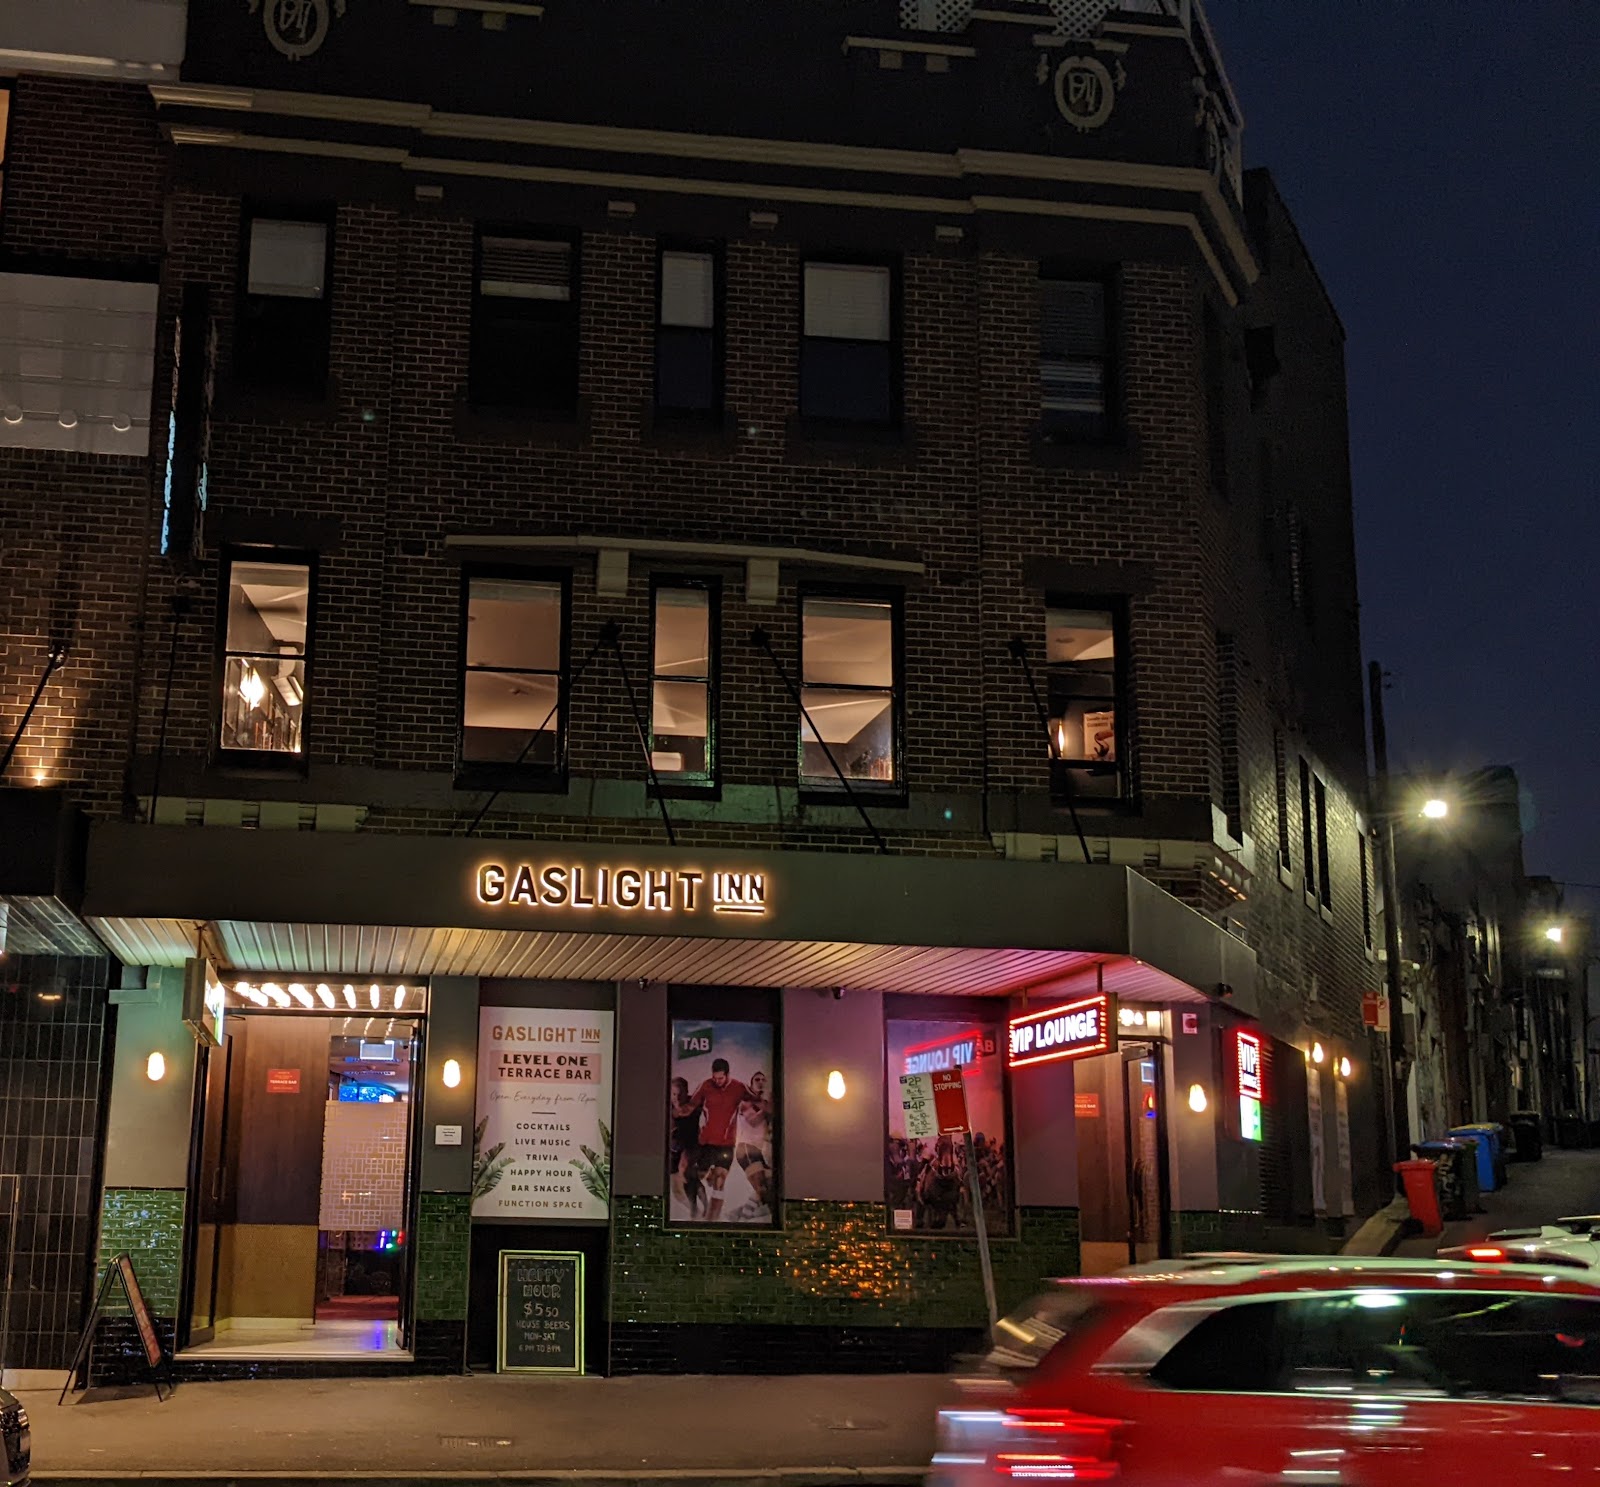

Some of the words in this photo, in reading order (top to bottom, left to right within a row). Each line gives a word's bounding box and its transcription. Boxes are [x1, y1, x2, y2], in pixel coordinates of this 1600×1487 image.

[476, 864, 703, 911] GASLIGHT
[713, 871, 766, 904] INN
[492, 1025, 577, 1042] GASLIGHT
[581, 1028, 601, 1040] INN
[1012, 1026, 1034, 1053] VIP
[1035, 1009, 1098, 1048] LOUNGE
[682, 1037, 710, 1050] TAB
[503, 1053, 552, 1065] LEVEL
[556, 1055, 589, 1067] ONE
[498, 1067, 561, 1079] TERRACE
[565, 1069, 592, 1080] BAR
[908, 1076, 921, 1086] 2P
[934, 1081, 962, 1091] STOPPING
[911, 1101, 925, 1109] 4P
[516, 1123, 571, 1131] COCKTAILS
[514, 1138, 537, 1146] LIVE
[540, 1138, 571, 1147] MUSIC
[510, 1169, 542, 1177] HAPPY
[545, 1169, 573, 1178] HOUR
[511, 1184, 530, 1193] BAR
[533, 1185, 572, 1193] SNACKS
[499, 1199, 549, 1208] FUNCTION
[552, 1201, 583, 1209] SPACE
[522, 1284, 561, 1298] HOUR
[543, 1320, 570, 1330] BEERS
